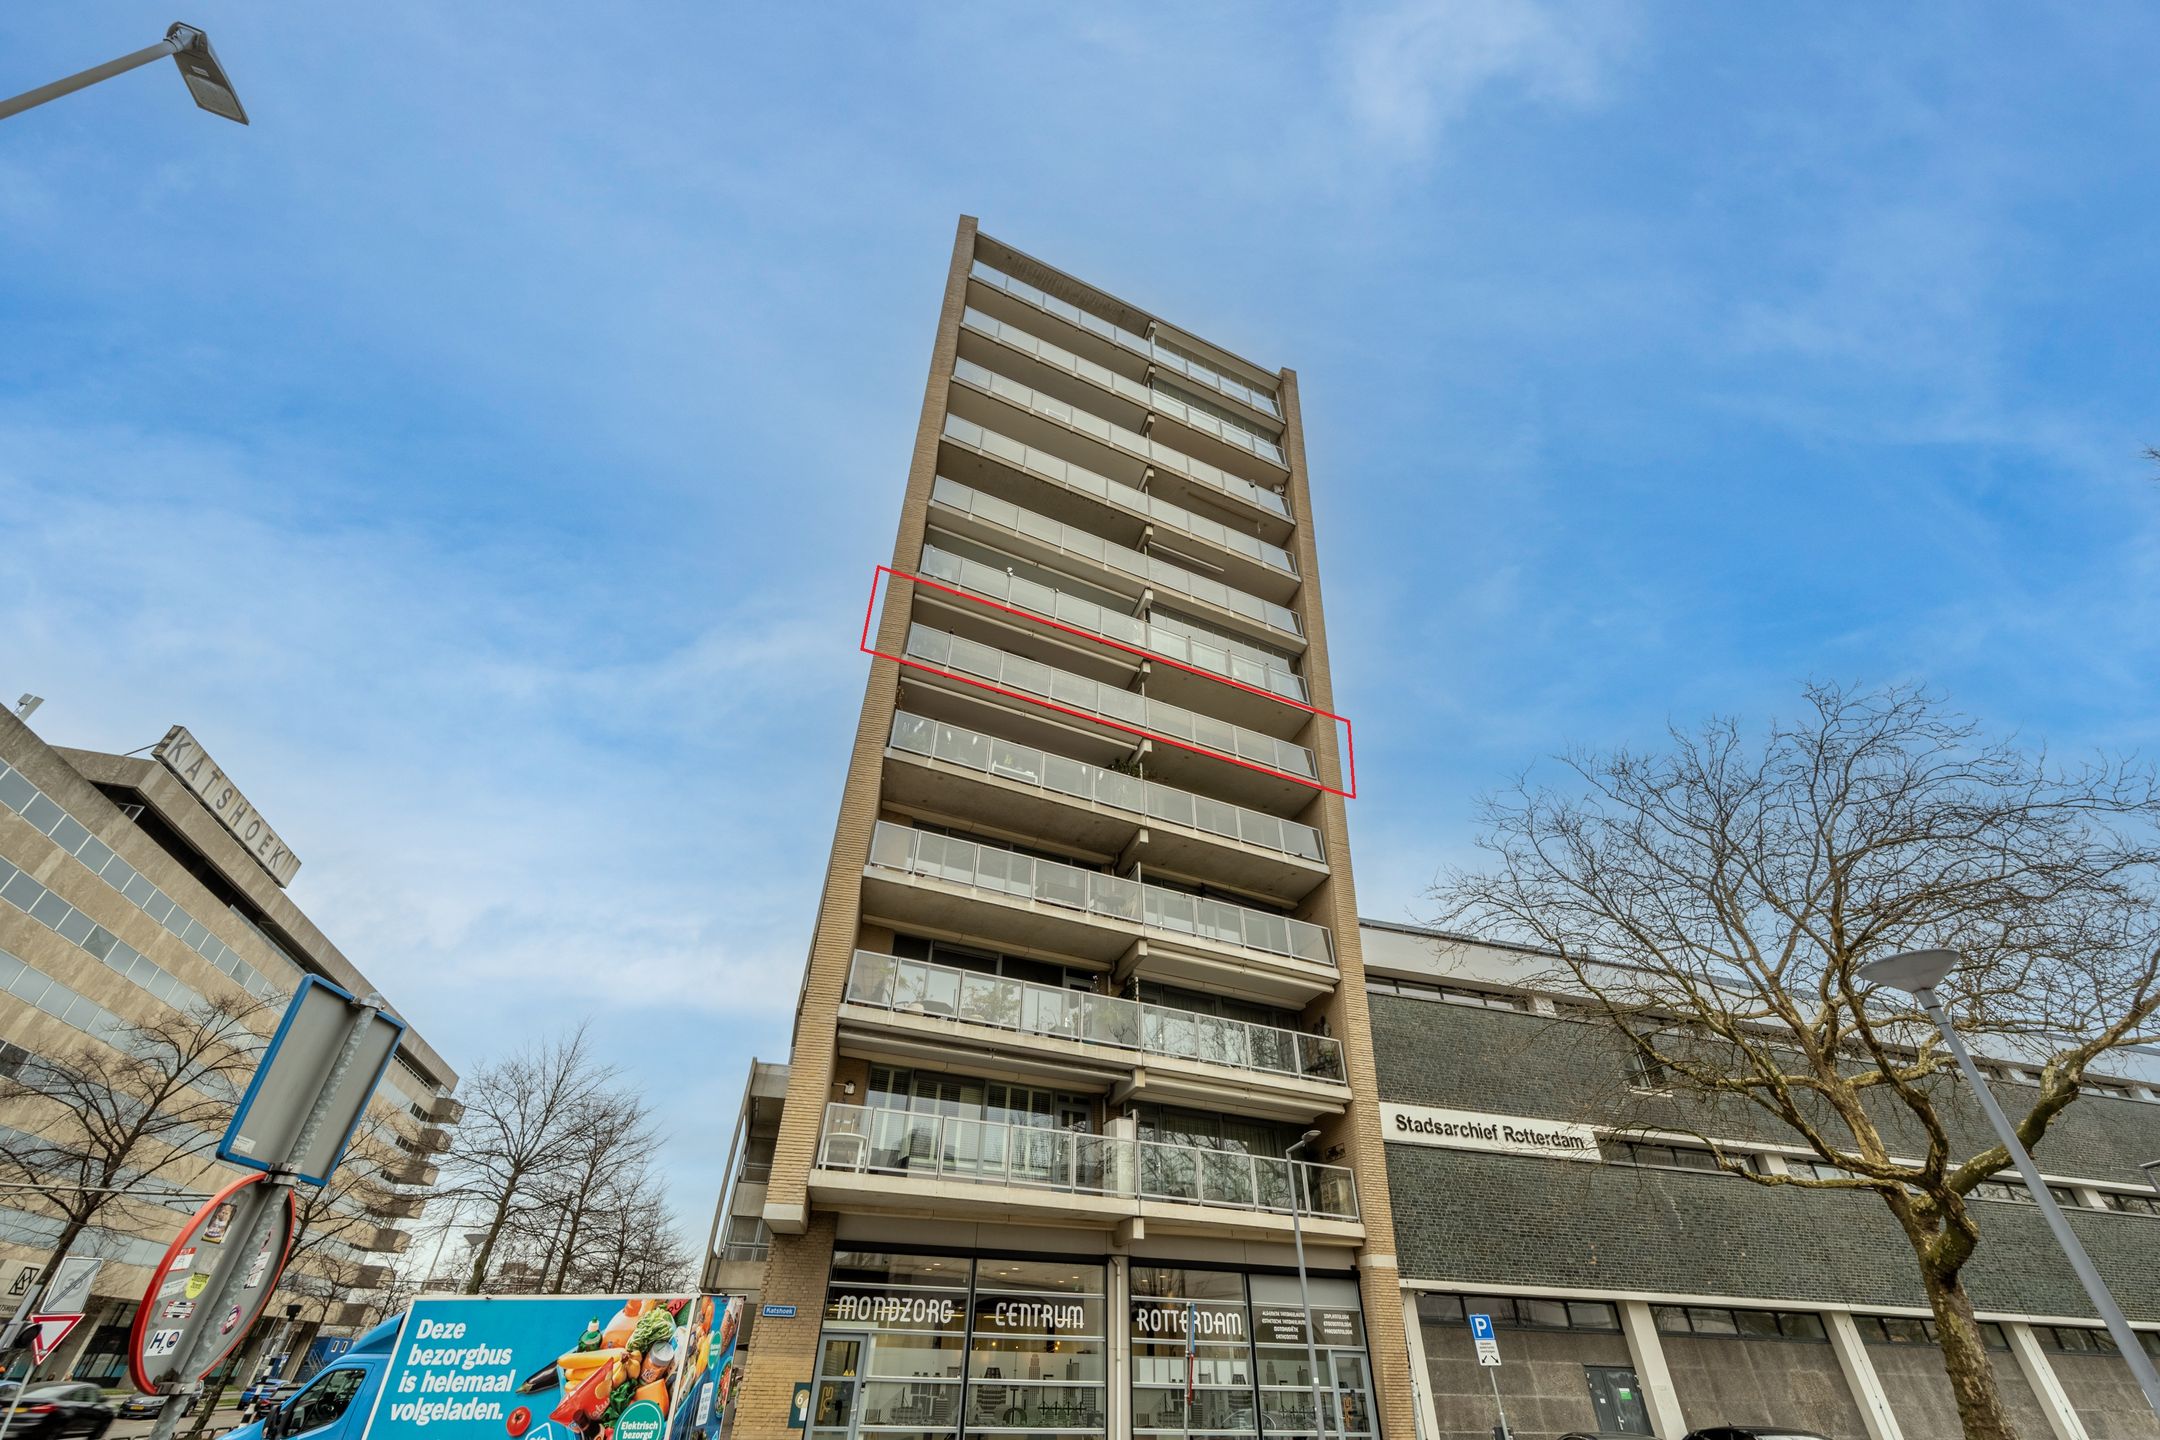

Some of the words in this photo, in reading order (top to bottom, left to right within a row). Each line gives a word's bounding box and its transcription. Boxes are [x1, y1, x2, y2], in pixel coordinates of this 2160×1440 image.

[167, 735, 285, 868] KATSHOEK
[1395, 1113, 1499, 1141] Stadsarchief
[1502, 1125, 1585, 1149] Rotterdam
[765, 1307, 794, 1315] Katshoek
[837, 1295, 955, 1324] MONDZORG
[995, 1302, 1085, 1329] CENTRUM
[1136, 1308, 1242, 1335] ROTTERDAM
[416, 1319, 467, 1339] Deze
[1475, 1317, 1487, 1337] P
[407, 1343, 513, 1370] bezorgbus
[397, 1370, 418, 1393] is
[420, 1369, 517, 1393] helemaal
[390, 1397, 504, 1426] volgeladen.
[621, 1421, 659, 1430] Elektrisch
[622, 1430, 654, 1440] bezorgd
